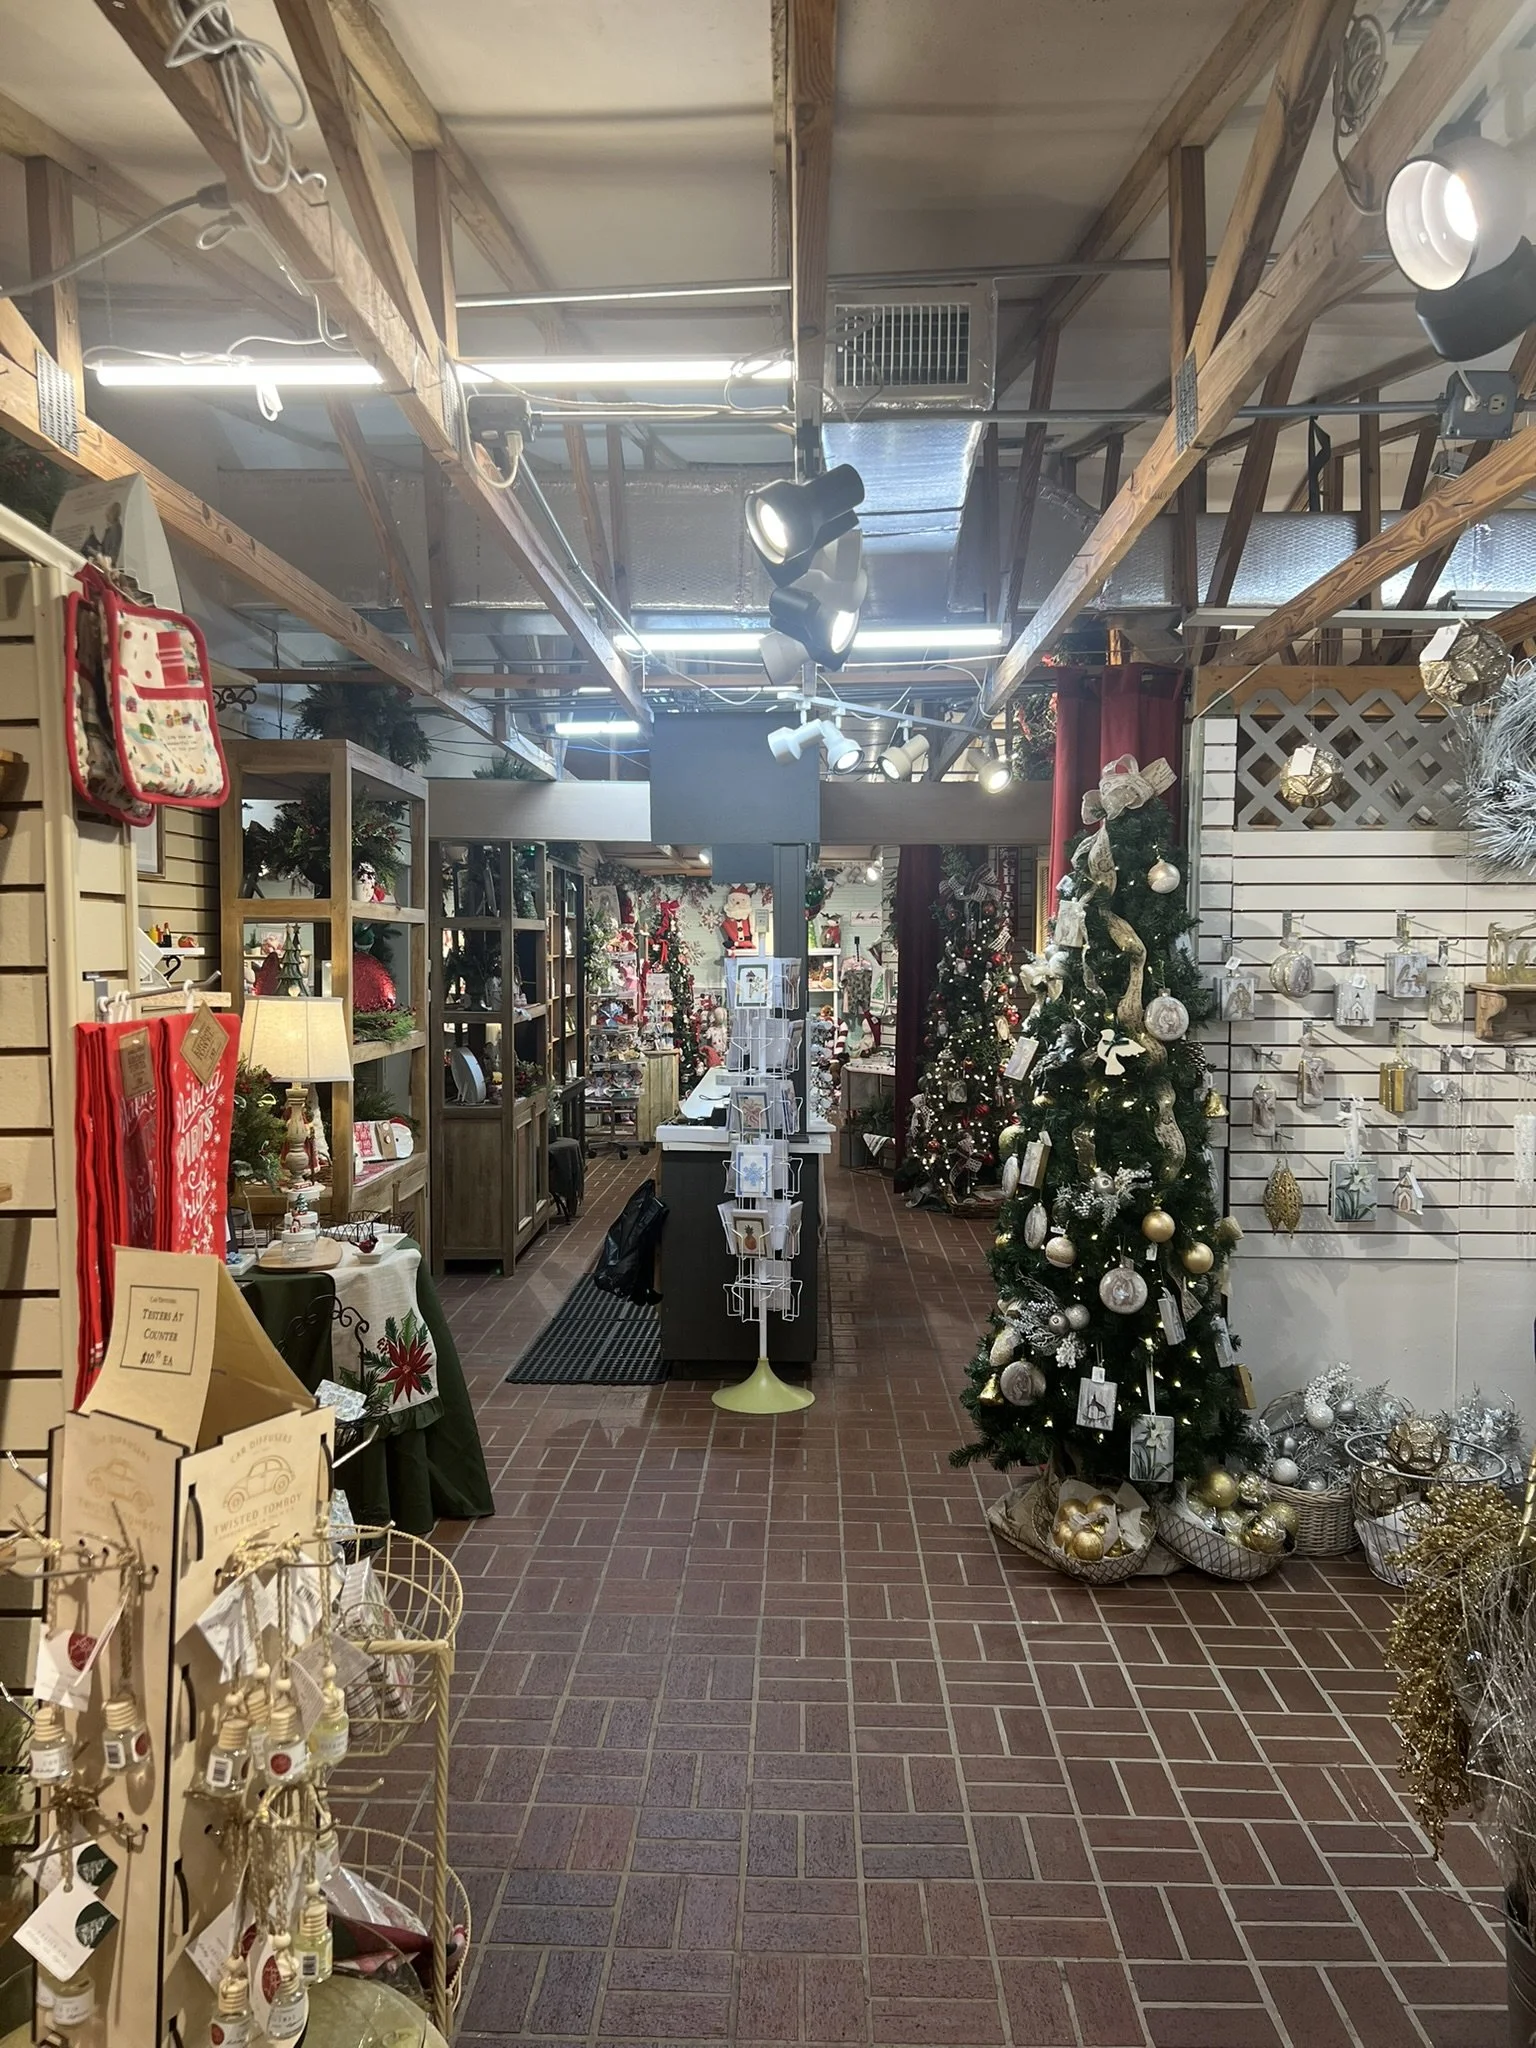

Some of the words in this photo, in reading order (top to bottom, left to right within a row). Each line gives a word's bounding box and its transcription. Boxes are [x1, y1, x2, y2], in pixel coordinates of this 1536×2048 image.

[143, 1308, 171, 1321] TESTERS
[172, 1312, 184, 1322] AT
[143, 1328, 178, 1342] COUNTER
[230, 1445, 247, 1464] CAR
[249, 1432, 293, 1450] DIFFUSERS
[213, 1508, 260, 1536] TWISTED
[263, 1492, 303, 1516] TOMBOY
